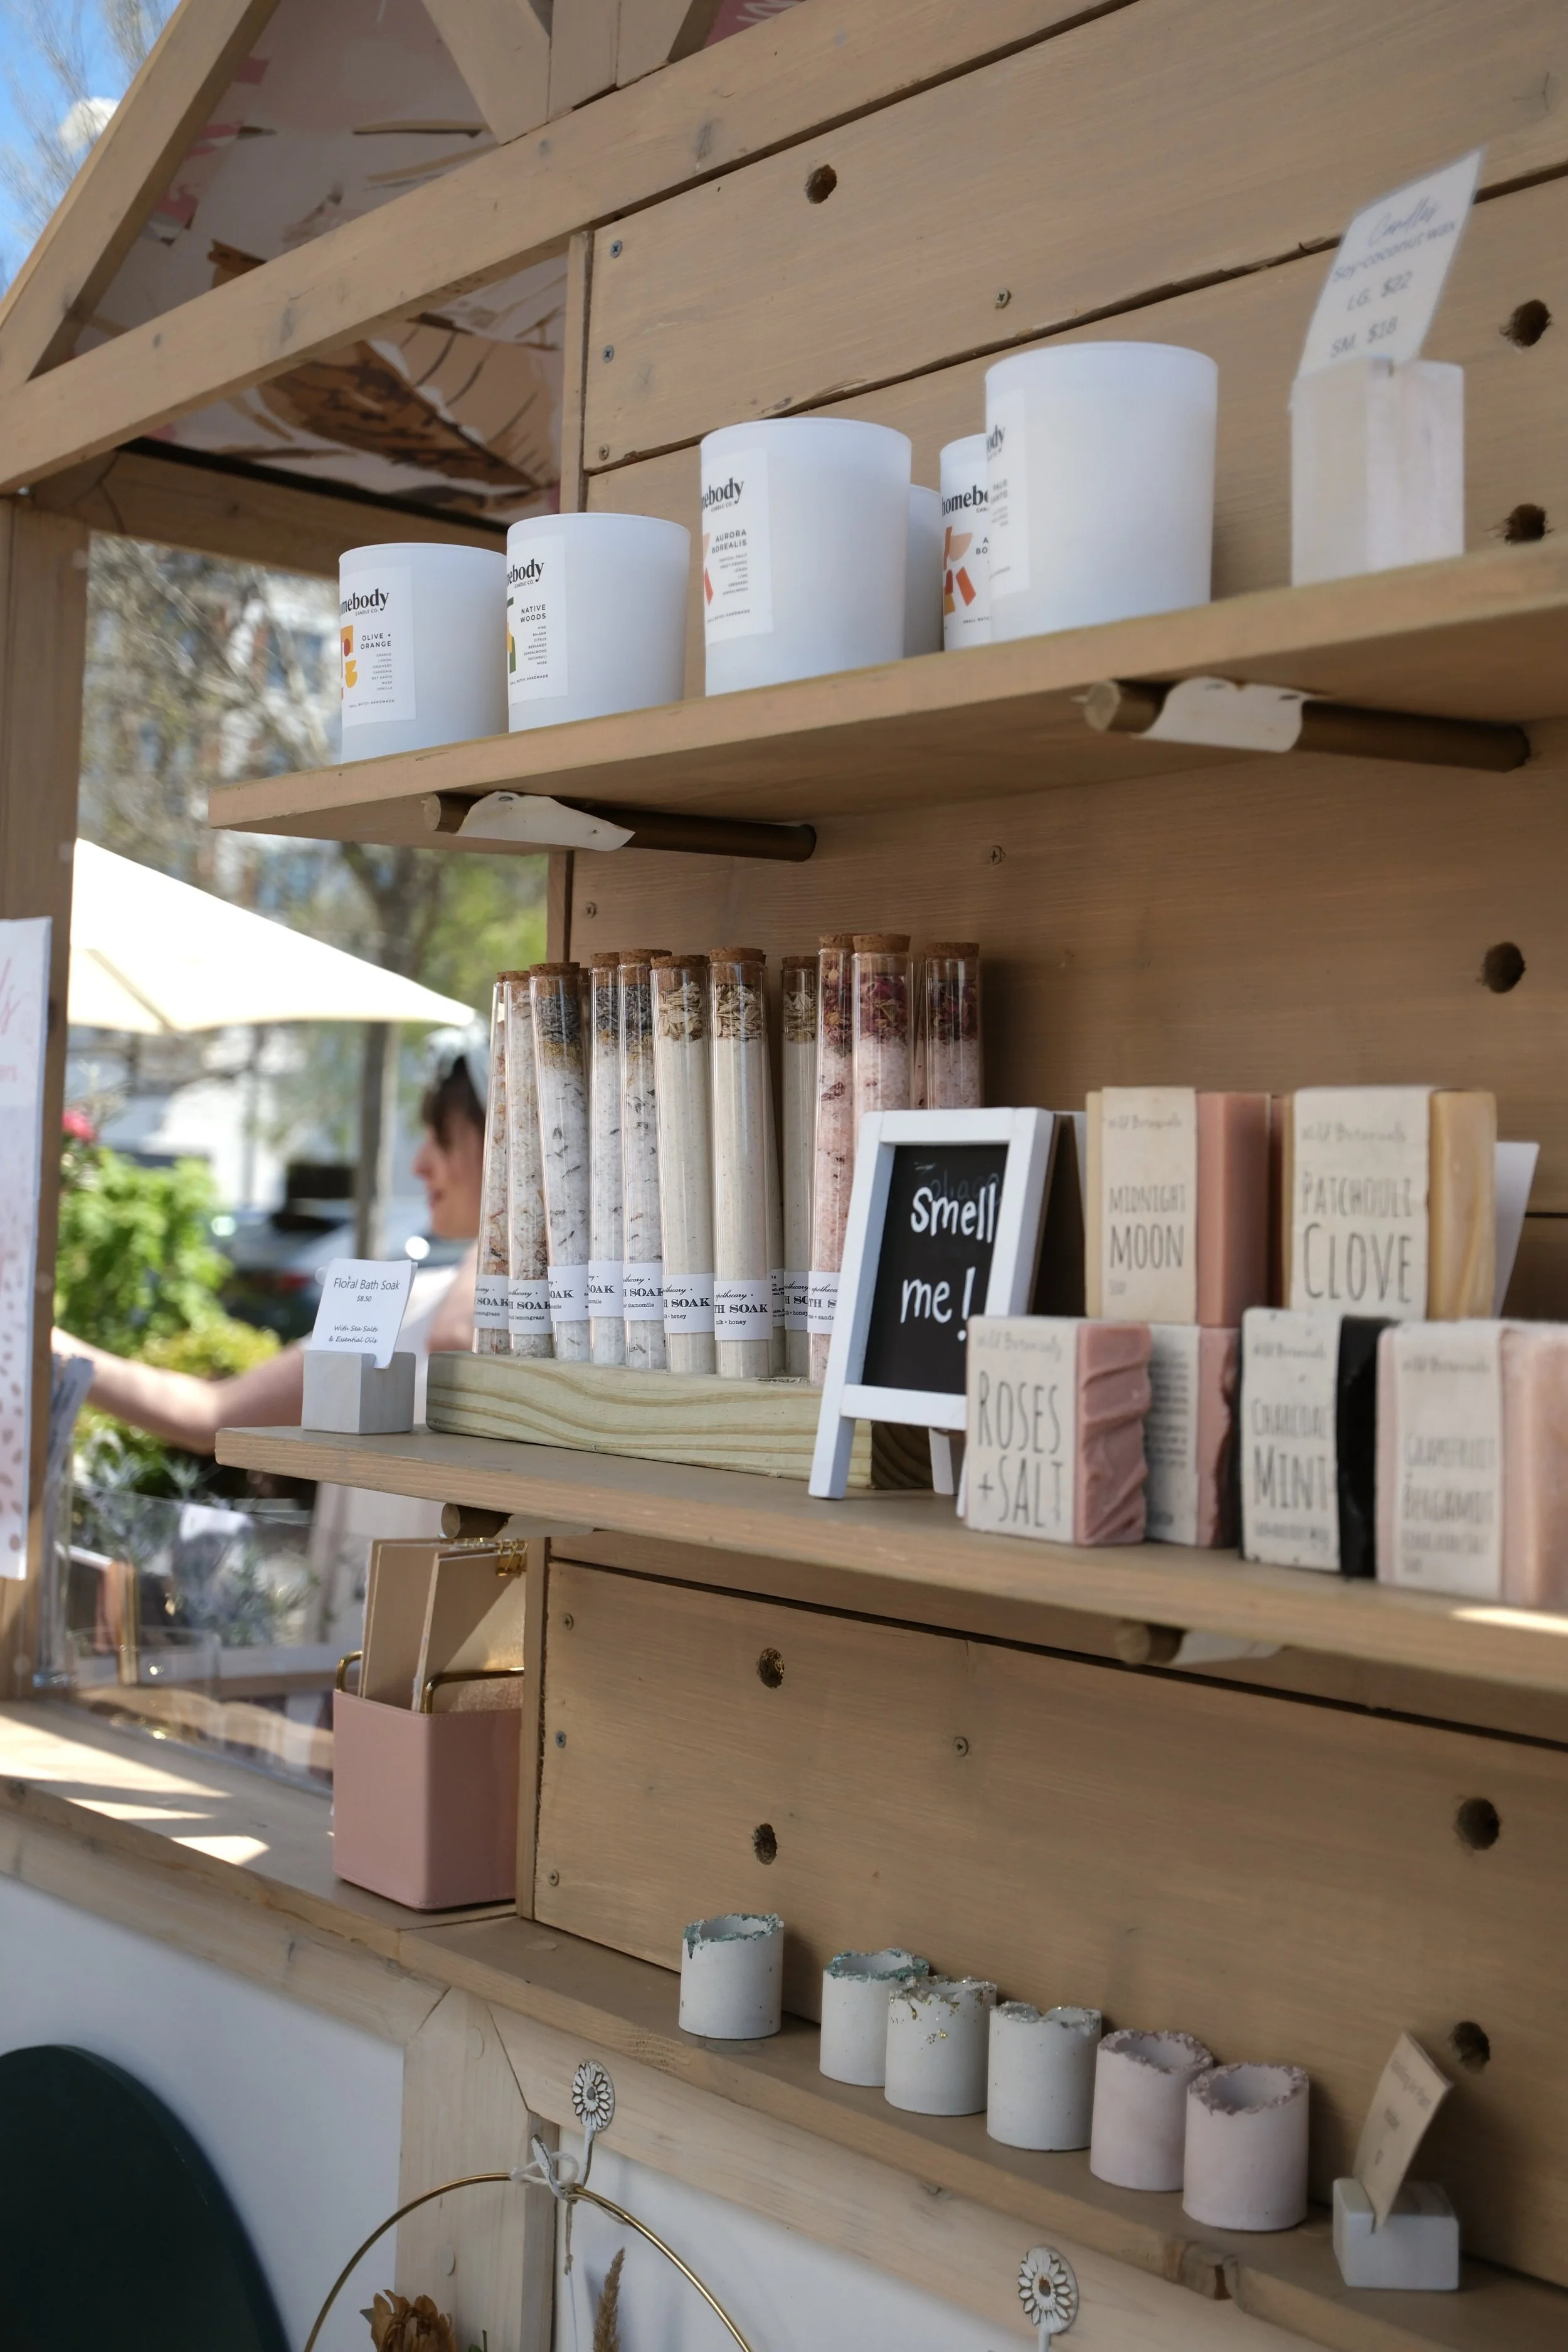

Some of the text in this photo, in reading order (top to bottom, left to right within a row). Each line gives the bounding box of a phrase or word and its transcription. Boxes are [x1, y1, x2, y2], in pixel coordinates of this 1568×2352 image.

[1347, 270, 1414, 311] LG $22
[1330, 332, 1356, 358] SM
[716, 529, 747, 543] AURORA
[712, 538, 748, 554] BOREALIS
[341, 588, 389, 615] mebody
[521, 604, 546, 615] NATIVE
[520, 613, 546, 623] WOODS
[360, 640, 392, 650] ORANGE
[362, 633, 384, 642] OLIVE
[1109, 1184, 1186, 1214] MIDNIGHT
[911, 1182, 996, 1244] Smell
[1110, 1224, 1184, 1271] MOON
[1303, 1222, 1412, 1303] CLOVE
[334, 1278, 400, 1290] Floral Bath Soak
[549, 1290, 575, 1298] OAK
[716, 1290, 748, 1301] apothecary
[477, 1297, 509, 1307] SOAK
[671, 1298, 711, 1308] SOAK
[729, 1304, 768, 1313] SOAK
[901, 1266, 975, 1342] me!
[978, 1370, 1061, 1455] ROSES
[1254, 1446, 1328, 1512] MINT
